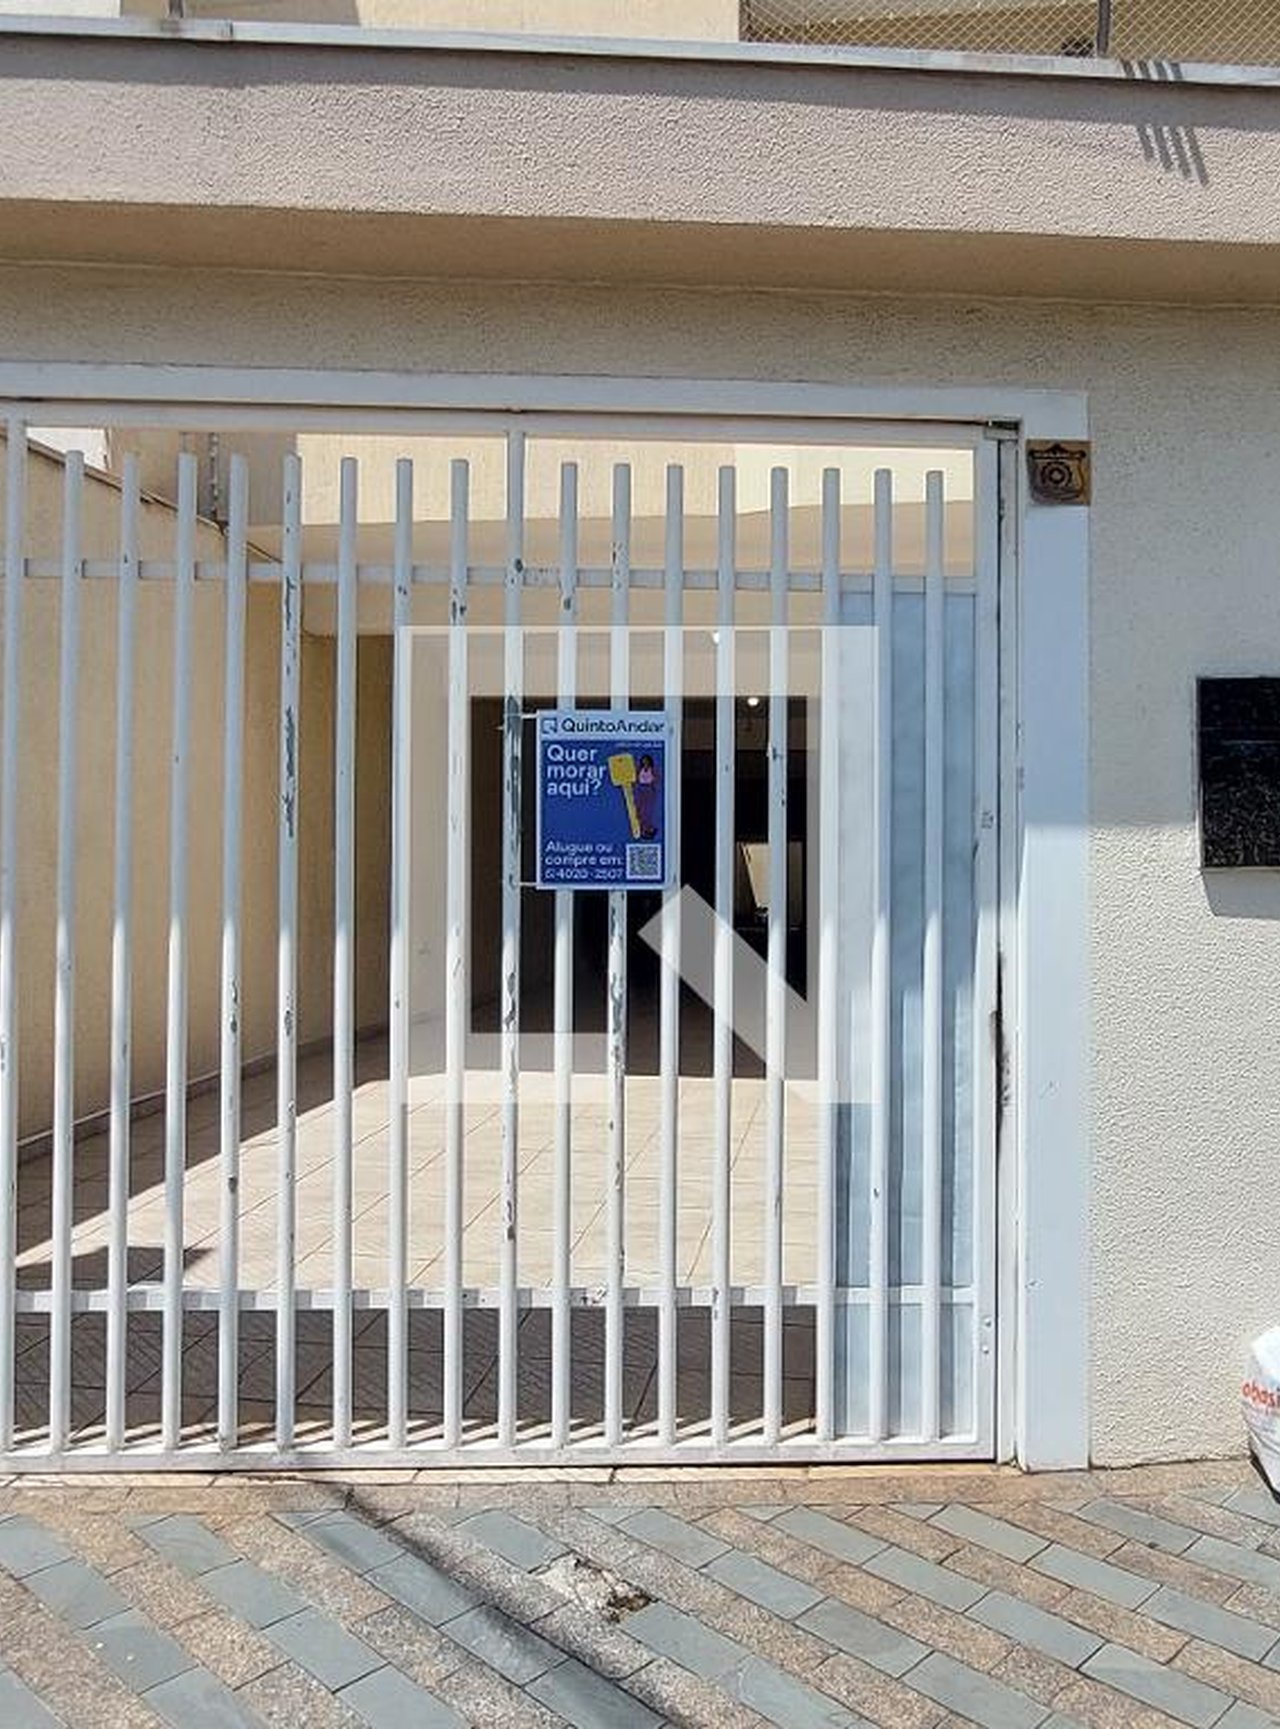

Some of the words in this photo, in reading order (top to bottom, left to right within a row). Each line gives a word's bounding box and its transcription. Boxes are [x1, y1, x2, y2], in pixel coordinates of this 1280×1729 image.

[561, 718, 665, 734] QuintoAndar
[547, 744, 598, 761] Quer
[547, 764, 607, 778] morar
[547, 779, 602, 799] aqui?
[545, 841, 593, 856] Alugue
[595, 843, 614, 853] ou
[544, 856, 597, 868] compre
